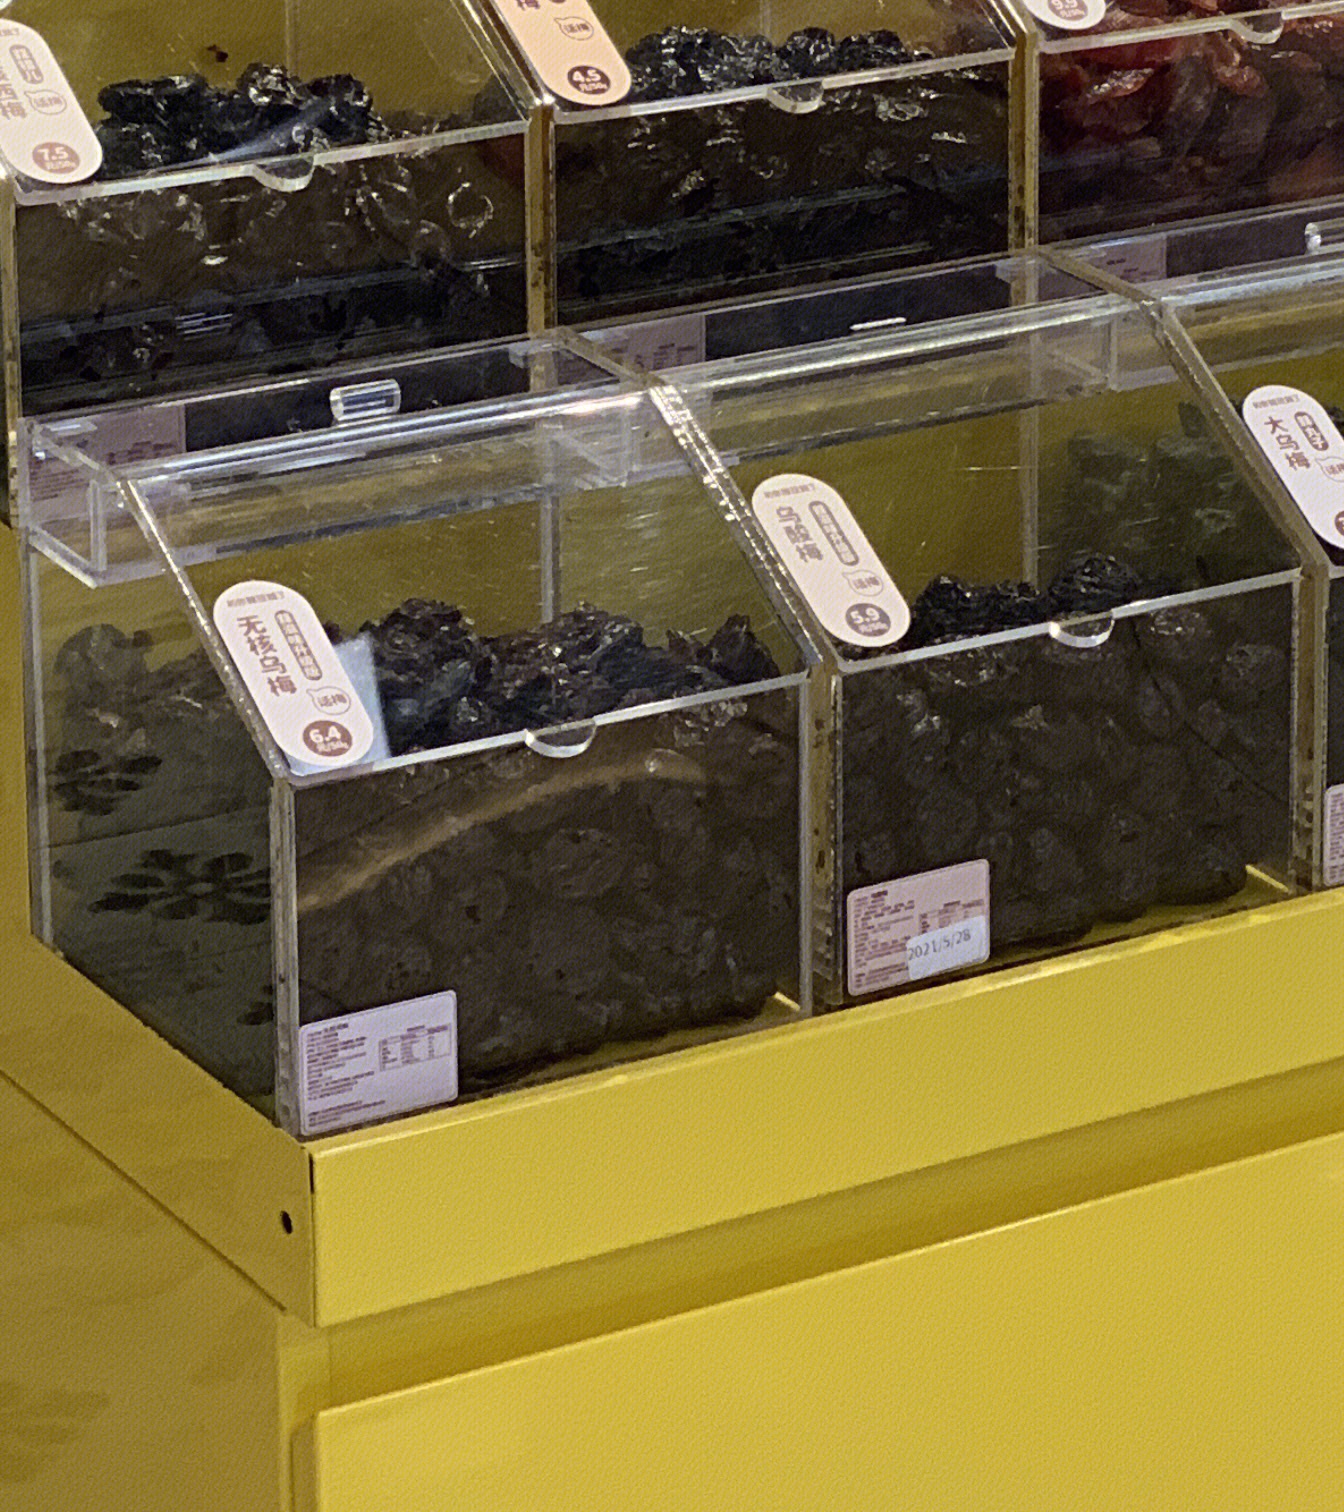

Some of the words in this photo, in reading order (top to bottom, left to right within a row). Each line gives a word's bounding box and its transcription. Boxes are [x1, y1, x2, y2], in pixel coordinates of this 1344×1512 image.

[572, 70, 601, 82] 4.5
[38, 149, 68, 160] 7.5
[1264, 416, 1311, 471] 大乌梅
[776, 506, 824, 562] 乌酸梅
[851, 610, 880, 624] 5.9
[237, 615, 297, 696] 无核乌梅
[318, 693, 347, 708] 话梅
[309, 727, 342, 743] 6.4
[908, 928, 971, 960] 2021/5/28
